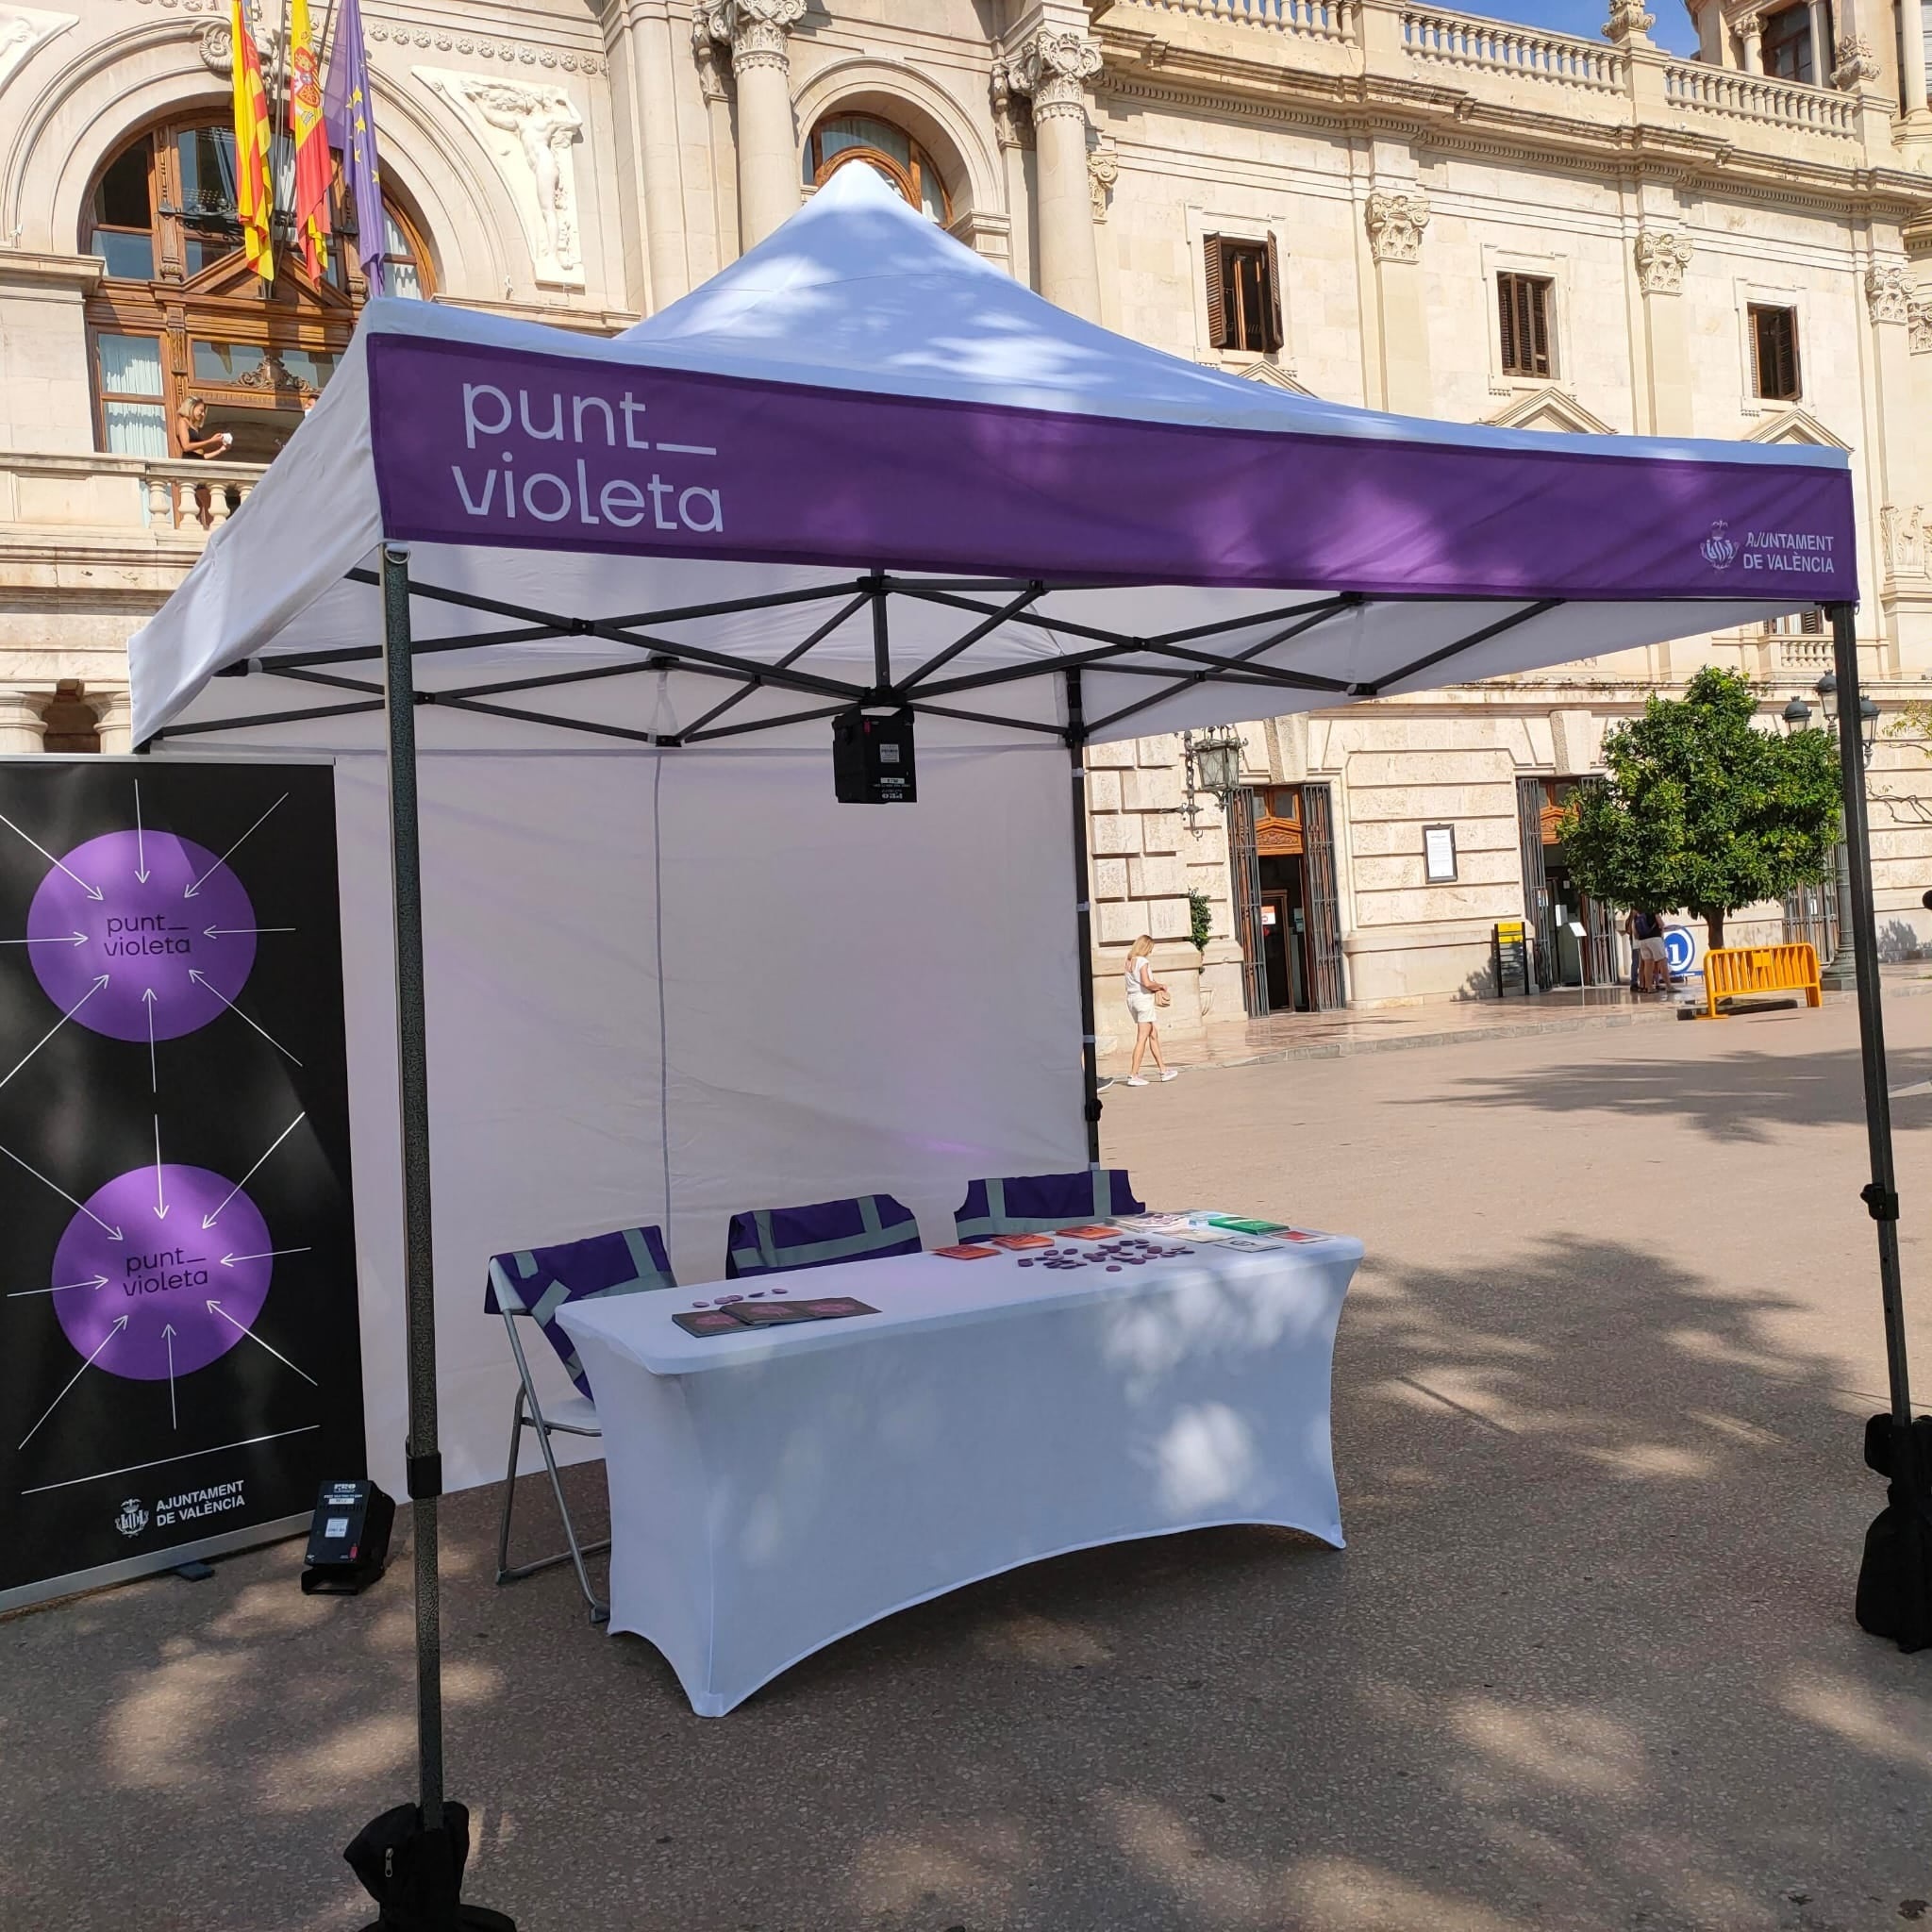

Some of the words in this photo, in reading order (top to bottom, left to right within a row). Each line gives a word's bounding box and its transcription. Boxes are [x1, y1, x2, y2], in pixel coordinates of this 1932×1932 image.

[451, 451, 724, 533] violeta
[1745, 532, 1834, 552] AJUNTAMENT
[1743, 553, 1763, 570] DE
[1767, 552, 1835, 574] VALÈNCIA
[104, 935, 191, 957] violeta
[123, 1270, 208, 1297] violeta
[156, 1479, 244, 1511] AJUNTAMENT
[156, 1512, 175, 1526] DE
[178, 1494, 245, 1522] VALÈNCIA
